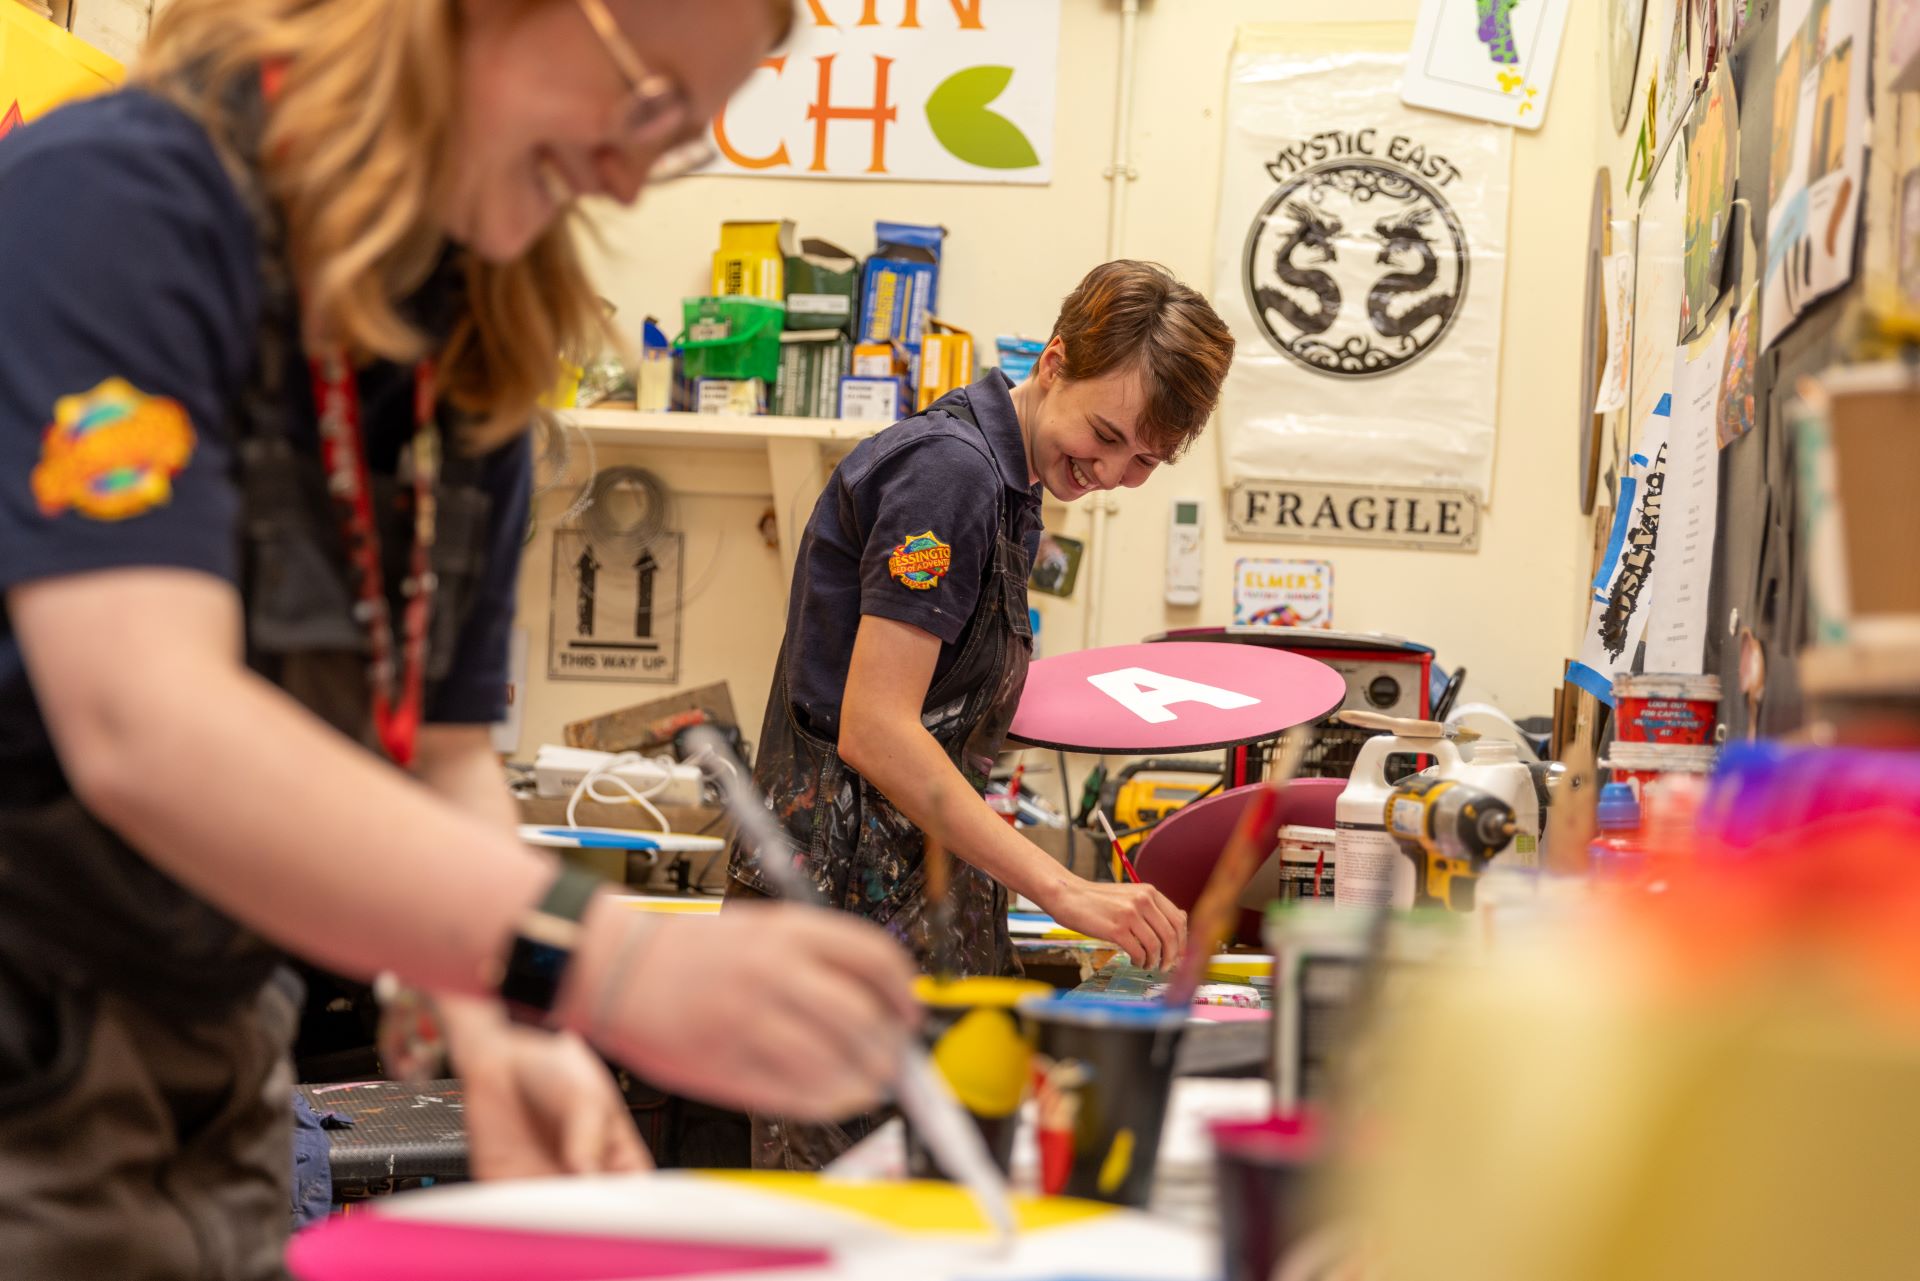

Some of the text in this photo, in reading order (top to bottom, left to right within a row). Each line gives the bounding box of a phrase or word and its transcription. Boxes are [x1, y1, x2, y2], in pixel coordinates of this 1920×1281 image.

[1264, 127, 1462, 187] MYSTIC EAST
[1244, 490, 1463, 536] FRAGILE
[559, 653, 667, 670] THIS WAY UP
[1087, 666, 1261, 724] A
